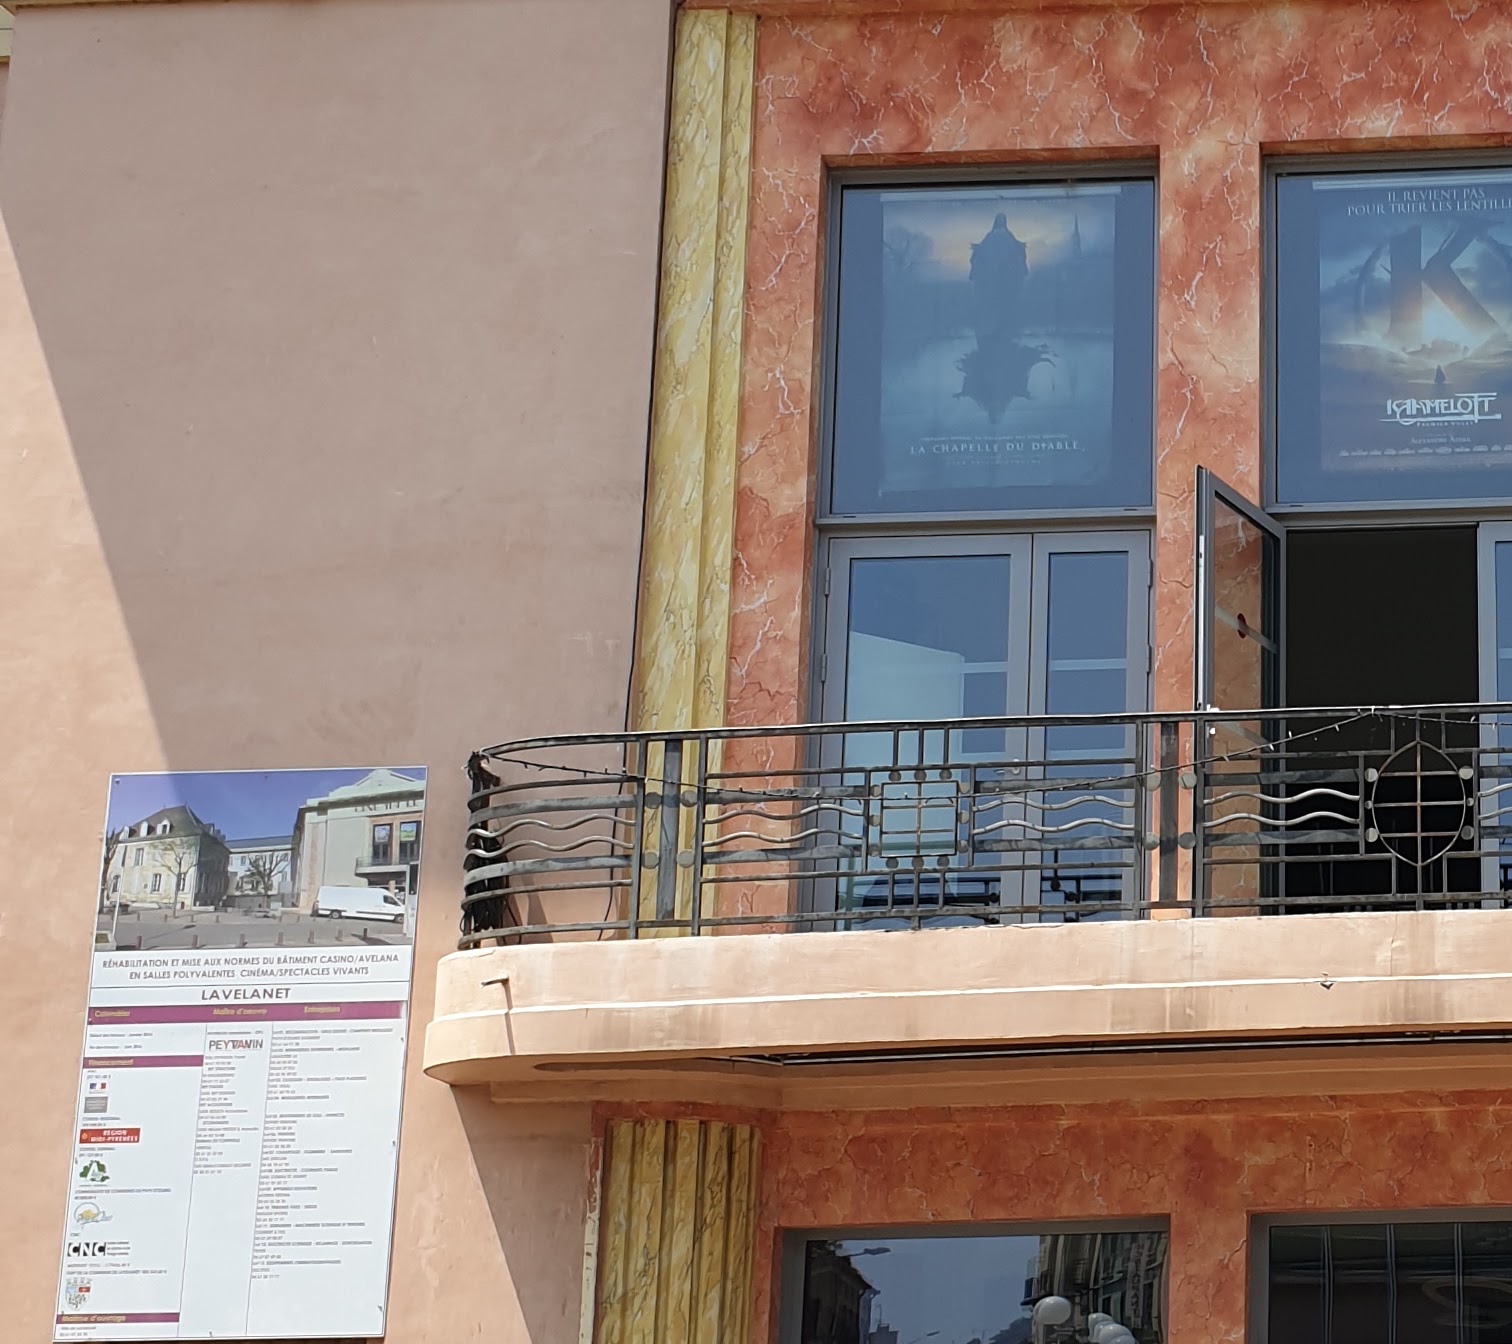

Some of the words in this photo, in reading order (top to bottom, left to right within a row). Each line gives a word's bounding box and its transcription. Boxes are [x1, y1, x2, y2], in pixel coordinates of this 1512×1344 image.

[1388, 191, 1399, 202] IL
[1403, 189, 1456, 202] REVIENT
[1463, 188, 1485, 199] PAS
[1347, 204, 1386, 216] POUR
[1389, 202, 1428, 214] TRIER
[1432, 201, 1452, 212] LES
[911, 445, 926, 454] LA
[932, 443, 999, 454] CHAPELLE
[1006, 442, 1024, 451] DU
[103, 957, 170, 968] RÉHABILITATION
[171, 957, 180, 966] ET
[182, 956, 201, 966] MISE
[204, 956, 222, 966] AUX
[224, 955, 260, 965] NORMES
[263, 955, 275, 965] DU
[277, 953, 317, 964] BÂTIMENT
[320, 953, 399, 964] CASINO/AVELANA
[129, 971, 141, 979] EN
[143, 970, 171, 979] SALLES
[173, 968, 235, 979] POLYVALENTES
[240, 966, 330, 977] CINÉMA/SPECTACLES
[333, 966, 369, 975] VIVANTS
[201, 987, 291, 1001] LAVELANET
[67, 1242, 106, 1257] CNC
